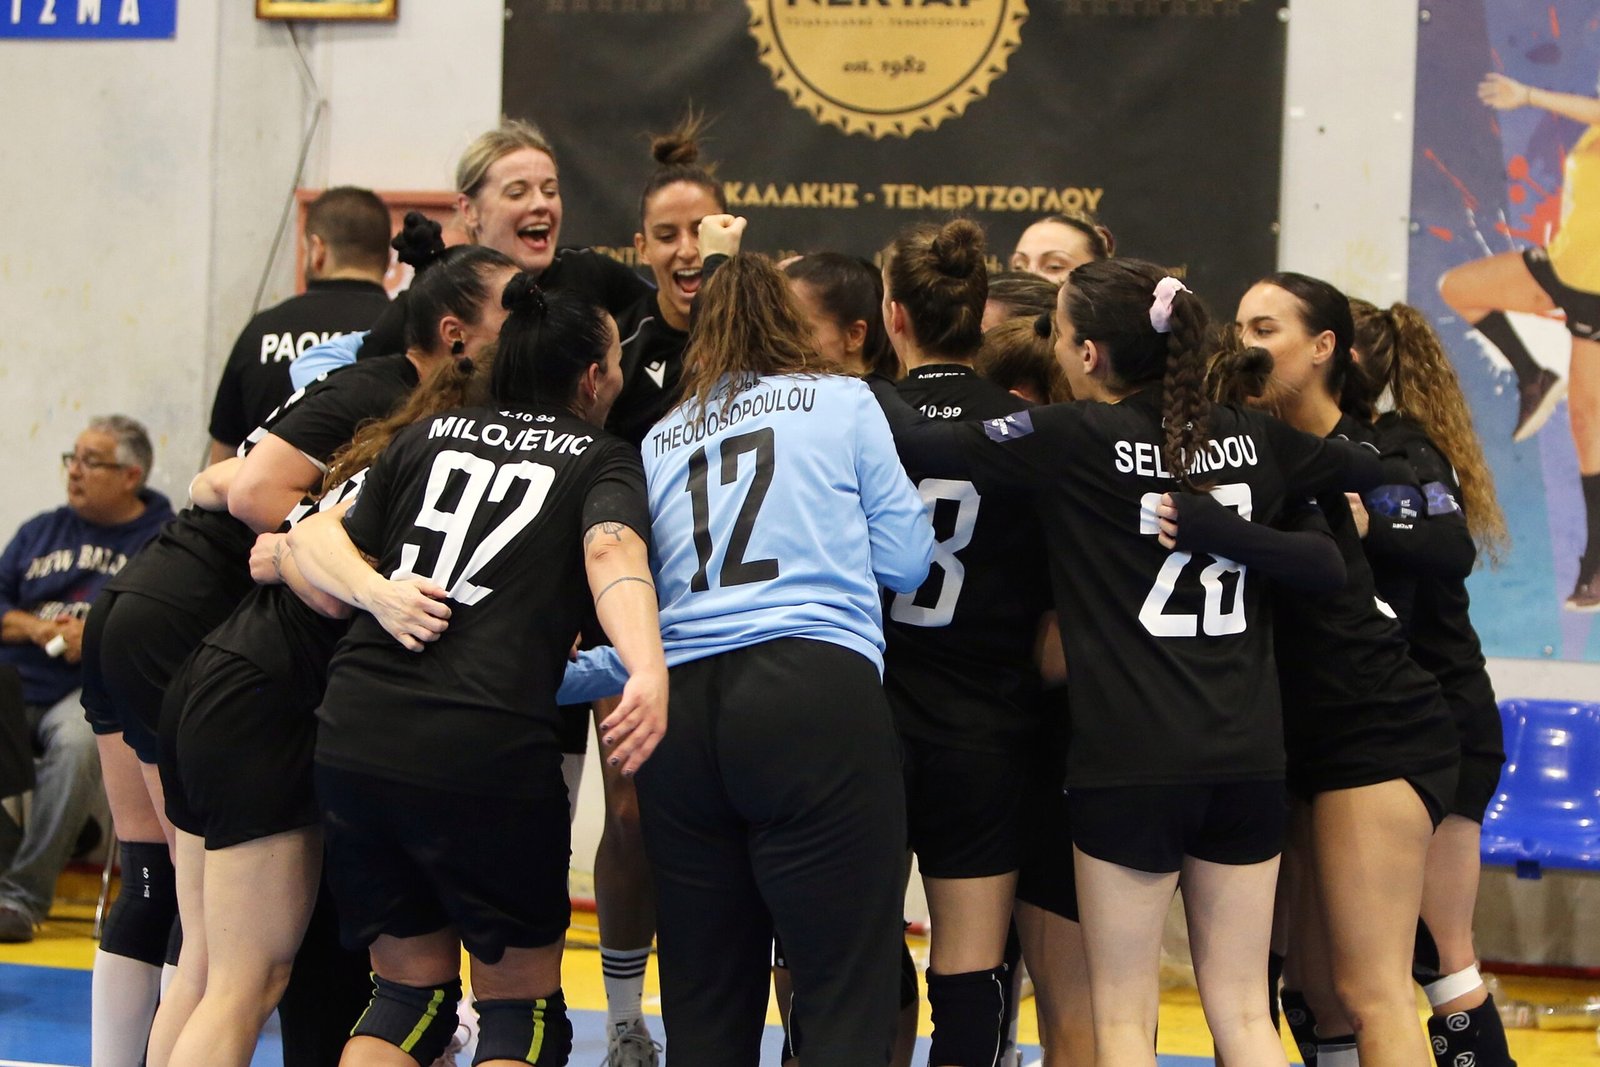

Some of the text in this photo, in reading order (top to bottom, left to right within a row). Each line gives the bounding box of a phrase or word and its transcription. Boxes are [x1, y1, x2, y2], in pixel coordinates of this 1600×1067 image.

[880, 54, 926, 81] 1982
[881, 183, 1104, 212] ΤΕΜΕΡΤΖΟΓΛΟΥ
[653, 387, 816, 458] THEODOSOPOULOU
[1114, 434, 1258, 479] SELMIDOU
[389, 450, 556, 606] 92
[685, 427, 780, 593] 12
